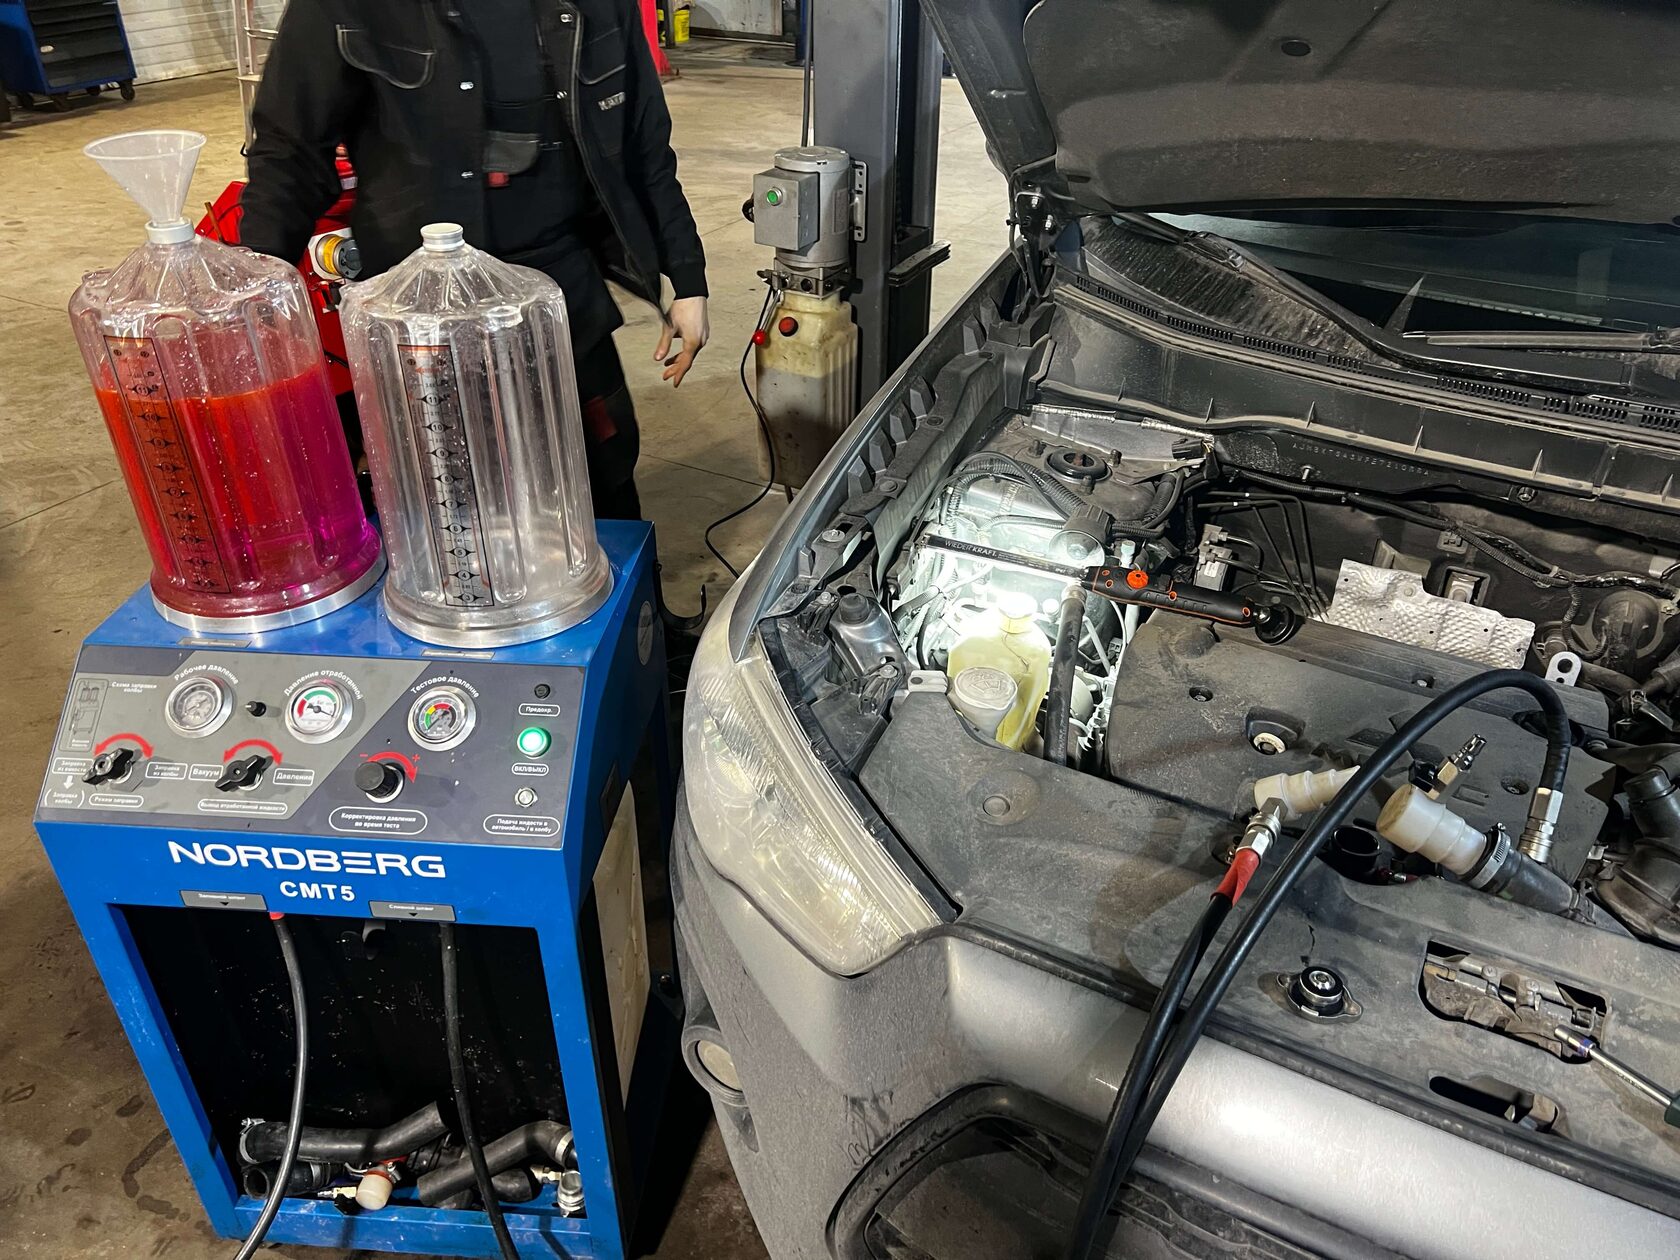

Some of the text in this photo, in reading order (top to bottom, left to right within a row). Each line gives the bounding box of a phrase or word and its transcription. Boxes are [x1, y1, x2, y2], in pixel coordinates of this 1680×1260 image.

[174, 664, 239, 685] Рабочее давление
[284, 670, 364, 700] Давление отработанной
[410, 676, 480, 698] Тестовое давление
[192, 768, 220, 777] Вакуум
[341, 812, 386, 821] Корректировка
[168, 840, 446, 878] NORDBERG
[280, 881, 356, 901] CMT5
